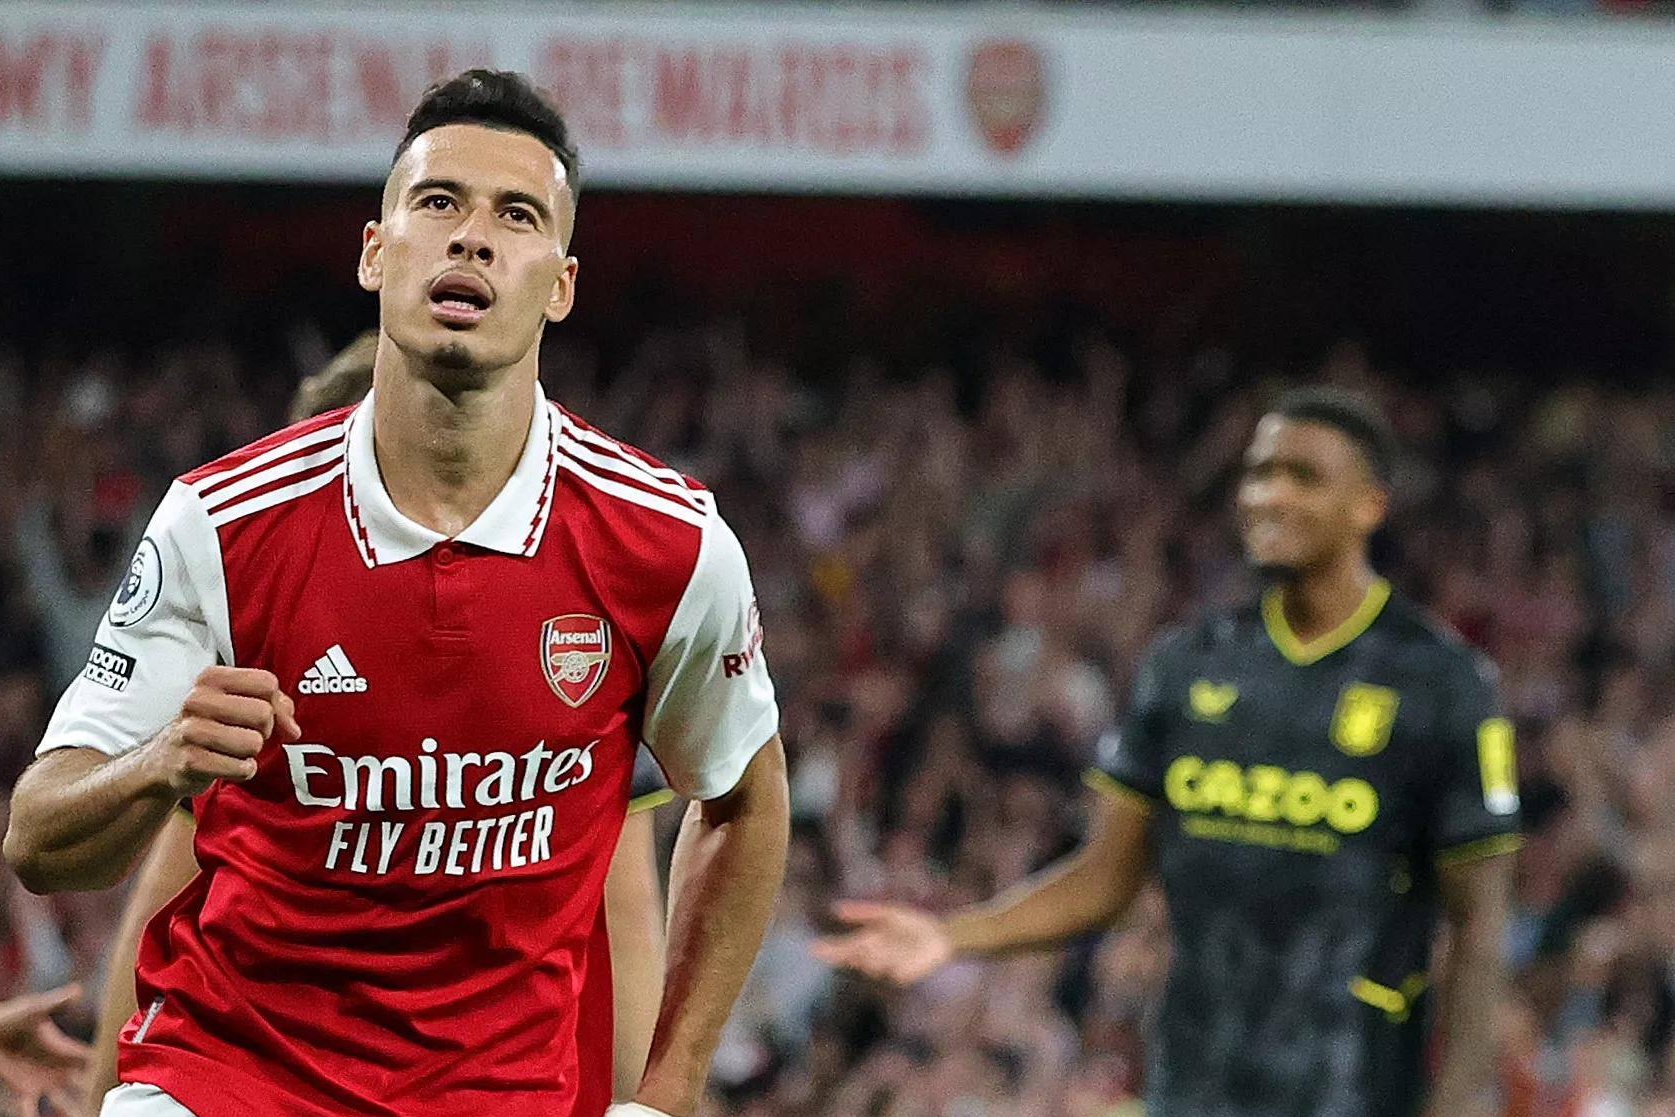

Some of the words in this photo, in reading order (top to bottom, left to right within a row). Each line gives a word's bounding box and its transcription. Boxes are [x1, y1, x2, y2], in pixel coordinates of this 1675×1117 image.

[550, 628, 601, 645] Arsenal
[297, 673, 367, 694] adidas
[282, 737, 602, 812] Emirates
[325, 820, 404, 876] FLY
[414, 805, 554, 877] BETTER
